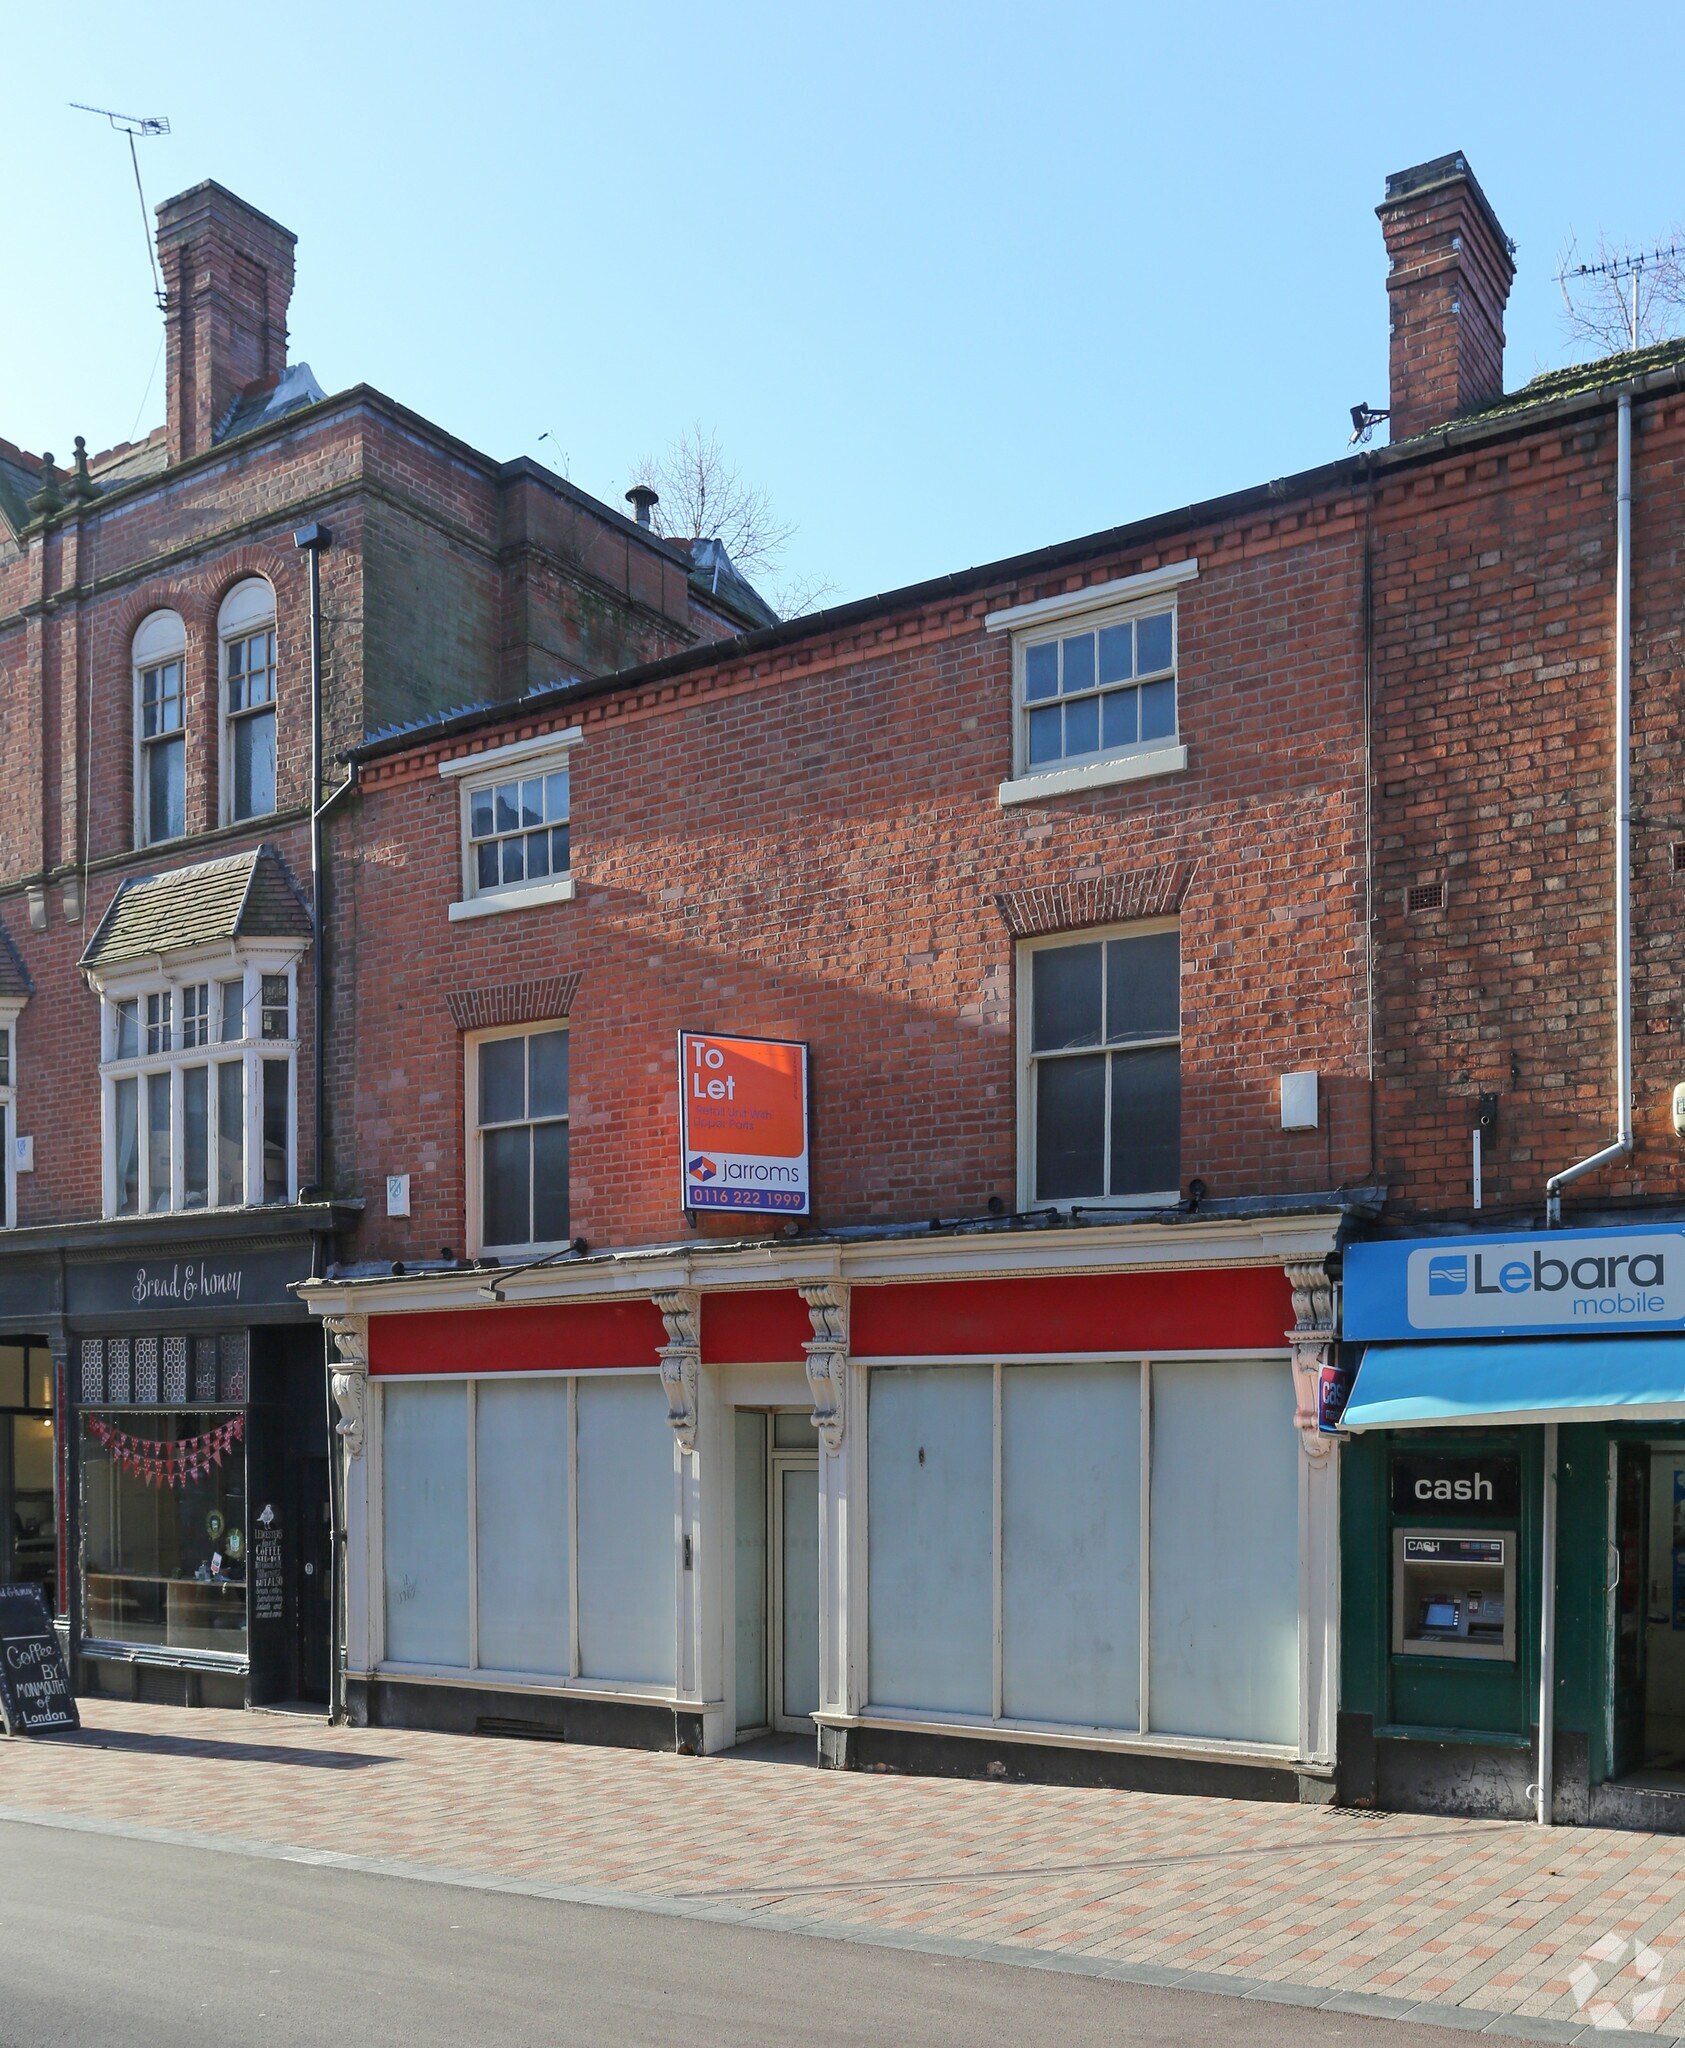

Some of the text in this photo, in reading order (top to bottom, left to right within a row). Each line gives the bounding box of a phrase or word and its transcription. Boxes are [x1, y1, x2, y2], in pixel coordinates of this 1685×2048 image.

[691, 1041, 724, 1069] To
[693, 1072, 736, 1101] Let
[722, 1159, 800, 1183] jarroms
[693, 1188, 801, 1207] 0116 222 1999
[131, 1261, 242, 1305] Bread & honey
[1474, 1250, 1665, 1294] Lebara
[1573, 1292, 1665, 1315] mobile
[1414, 1472, 1493, 1501] cash
[6, 1642, 56, 1670] Coffee
[41, 1663, 59, 1680] BY
[16, 1679, 67, 1699] MONMOUTH
[36, 1696, 51, 1709] of
[22, 1707, 67, 1725] London
